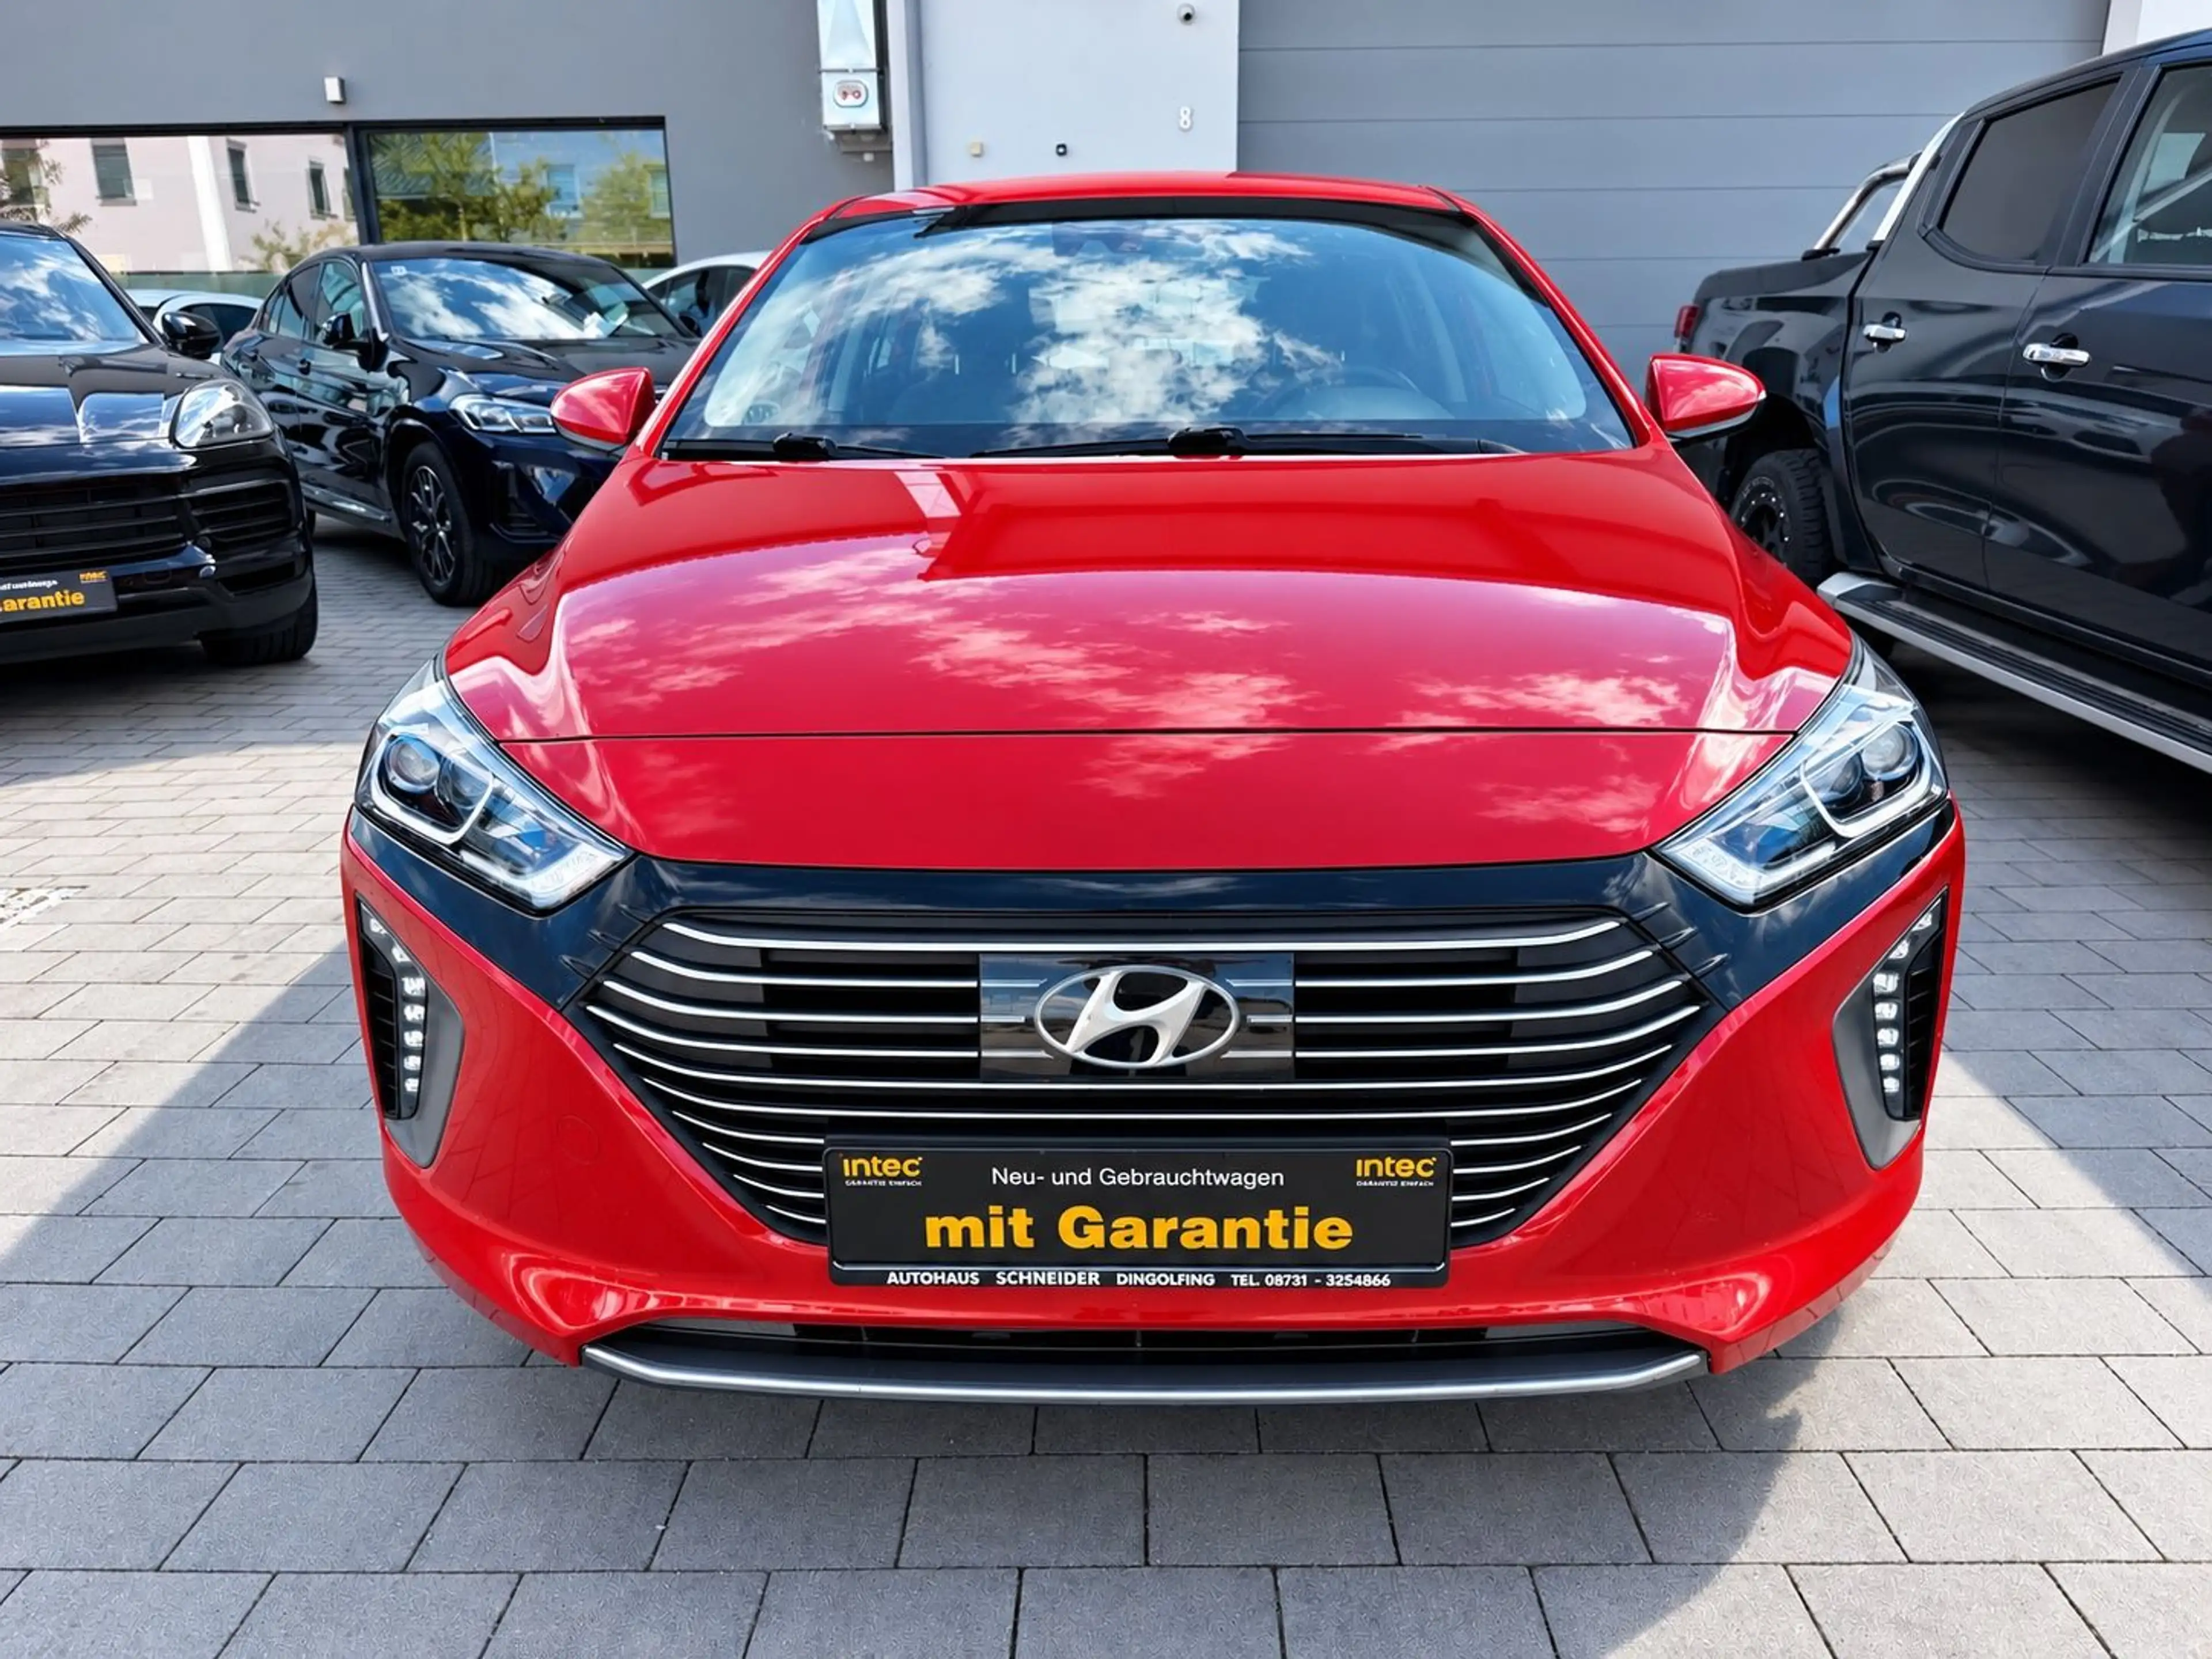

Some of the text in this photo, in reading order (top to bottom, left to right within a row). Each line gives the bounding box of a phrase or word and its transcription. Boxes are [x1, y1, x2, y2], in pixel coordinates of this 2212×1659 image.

[0, 589, 85, 612] arantie
[842, 1156, 921, 1177] intec
[1355, 1157, 1435, 1179] intec
[992, 1166, 1284, 1191] Neu- und Gebrauchtwagen
[925, 1205, 1353, 1251] mit Garantie
[886, 1271, 980, 1286] AUTOHAUS
[995, 1271, 1101, 1286] SCHNEIDER
[1116, 1272, 1216, 1286] DINGOLFING
[1230, 1274, 1260, 1286] TEL.
[1264, 1274, 1308, 1287] 08731
[1325, 1274, 1392, 1287] 3254866
